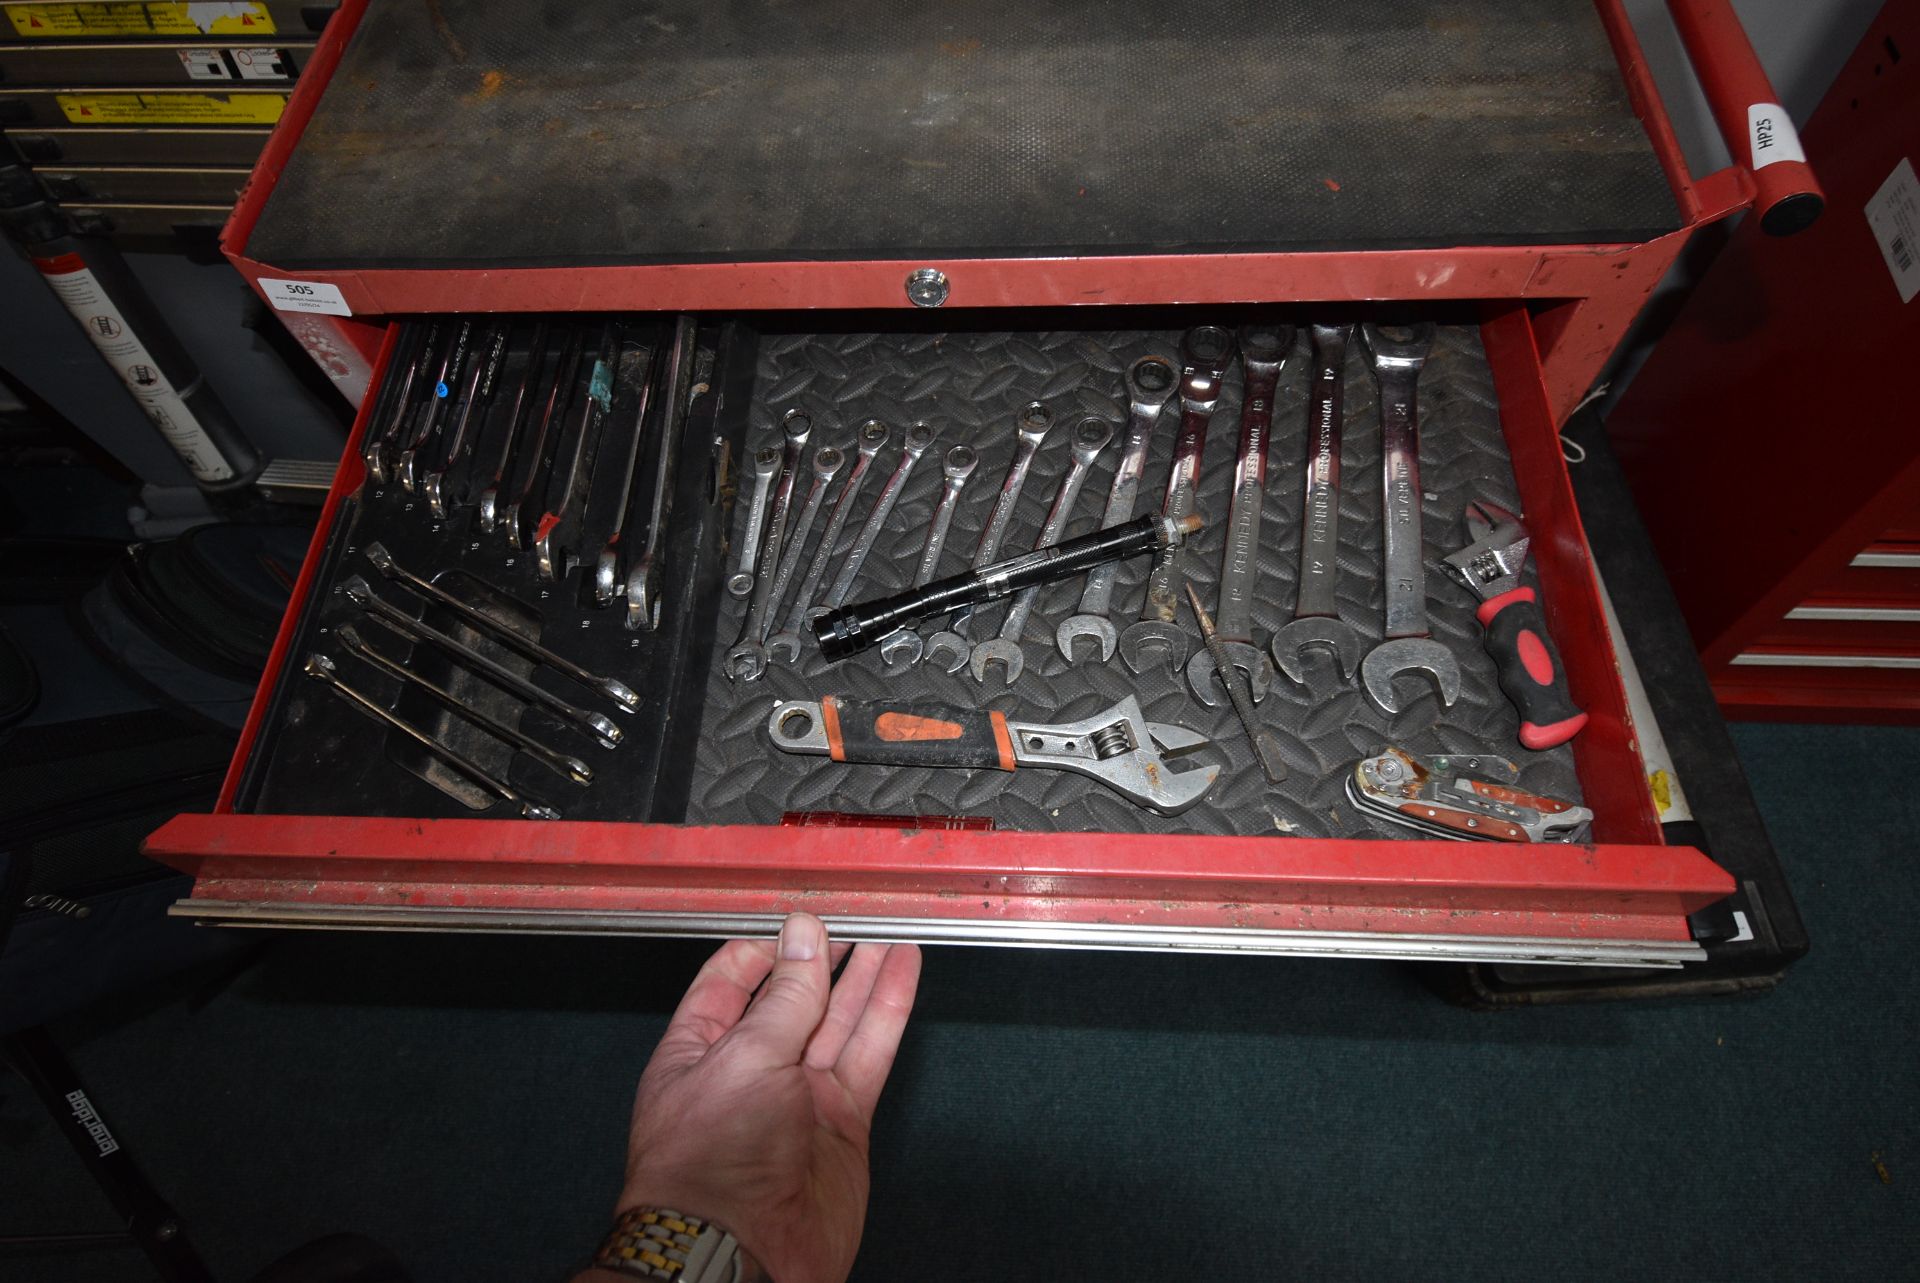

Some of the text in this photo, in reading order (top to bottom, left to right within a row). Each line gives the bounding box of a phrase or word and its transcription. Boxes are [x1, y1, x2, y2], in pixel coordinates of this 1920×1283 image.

[1756, 118, 1773, 150] HP25
[286, 284, 314, 295] 505
[1233, 509, 1252, 574] KENNEDY
